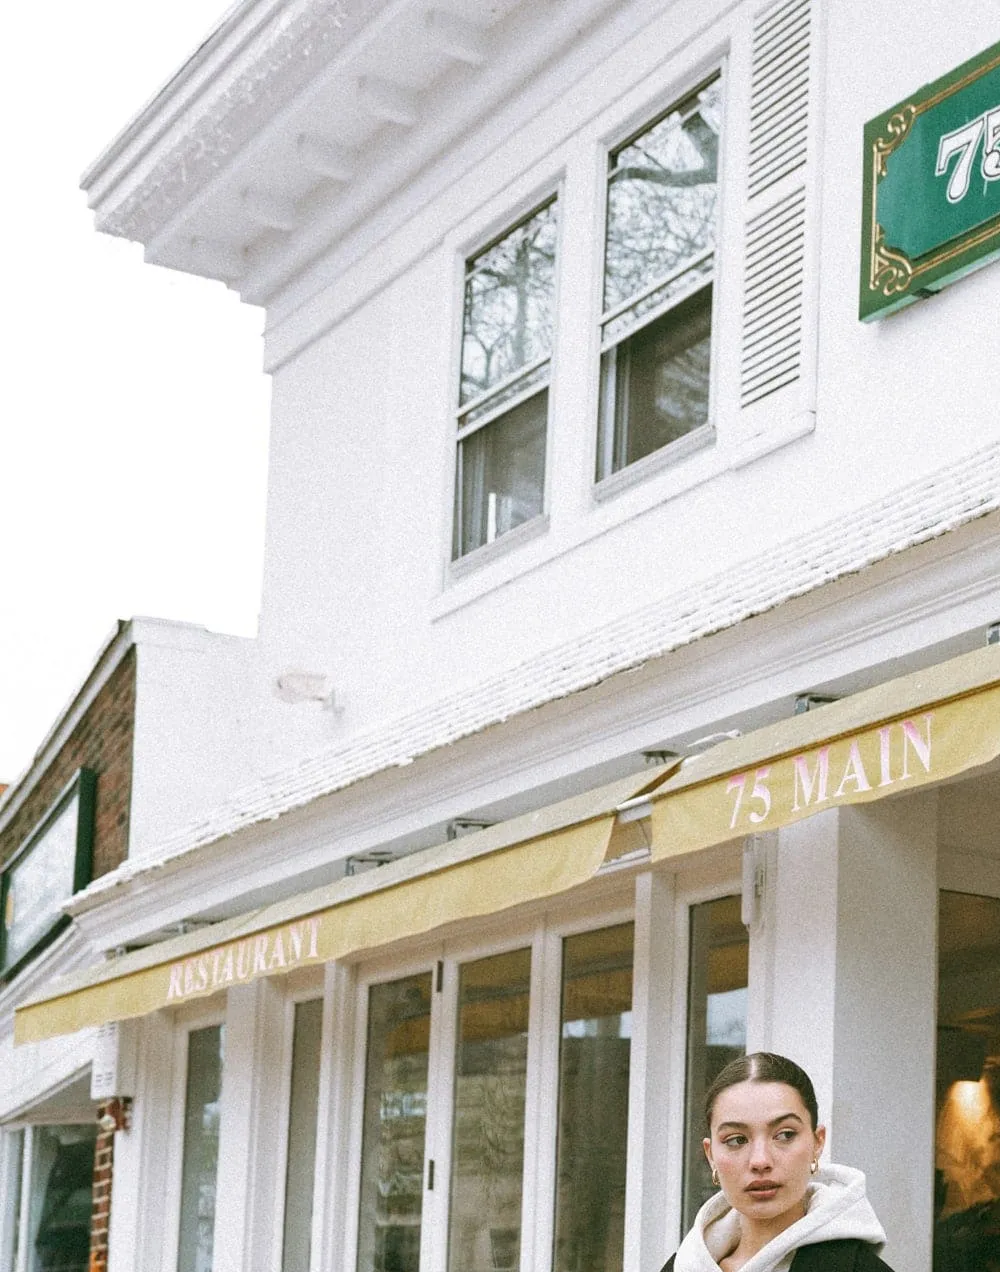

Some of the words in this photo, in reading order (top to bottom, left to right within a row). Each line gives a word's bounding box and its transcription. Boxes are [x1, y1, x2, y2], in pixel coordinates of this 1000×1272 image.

[727, 768, 771, 829] 75
[791, 714, 934, 812] MAIN
[166, 918, 322, 1000] RESTAURANT
